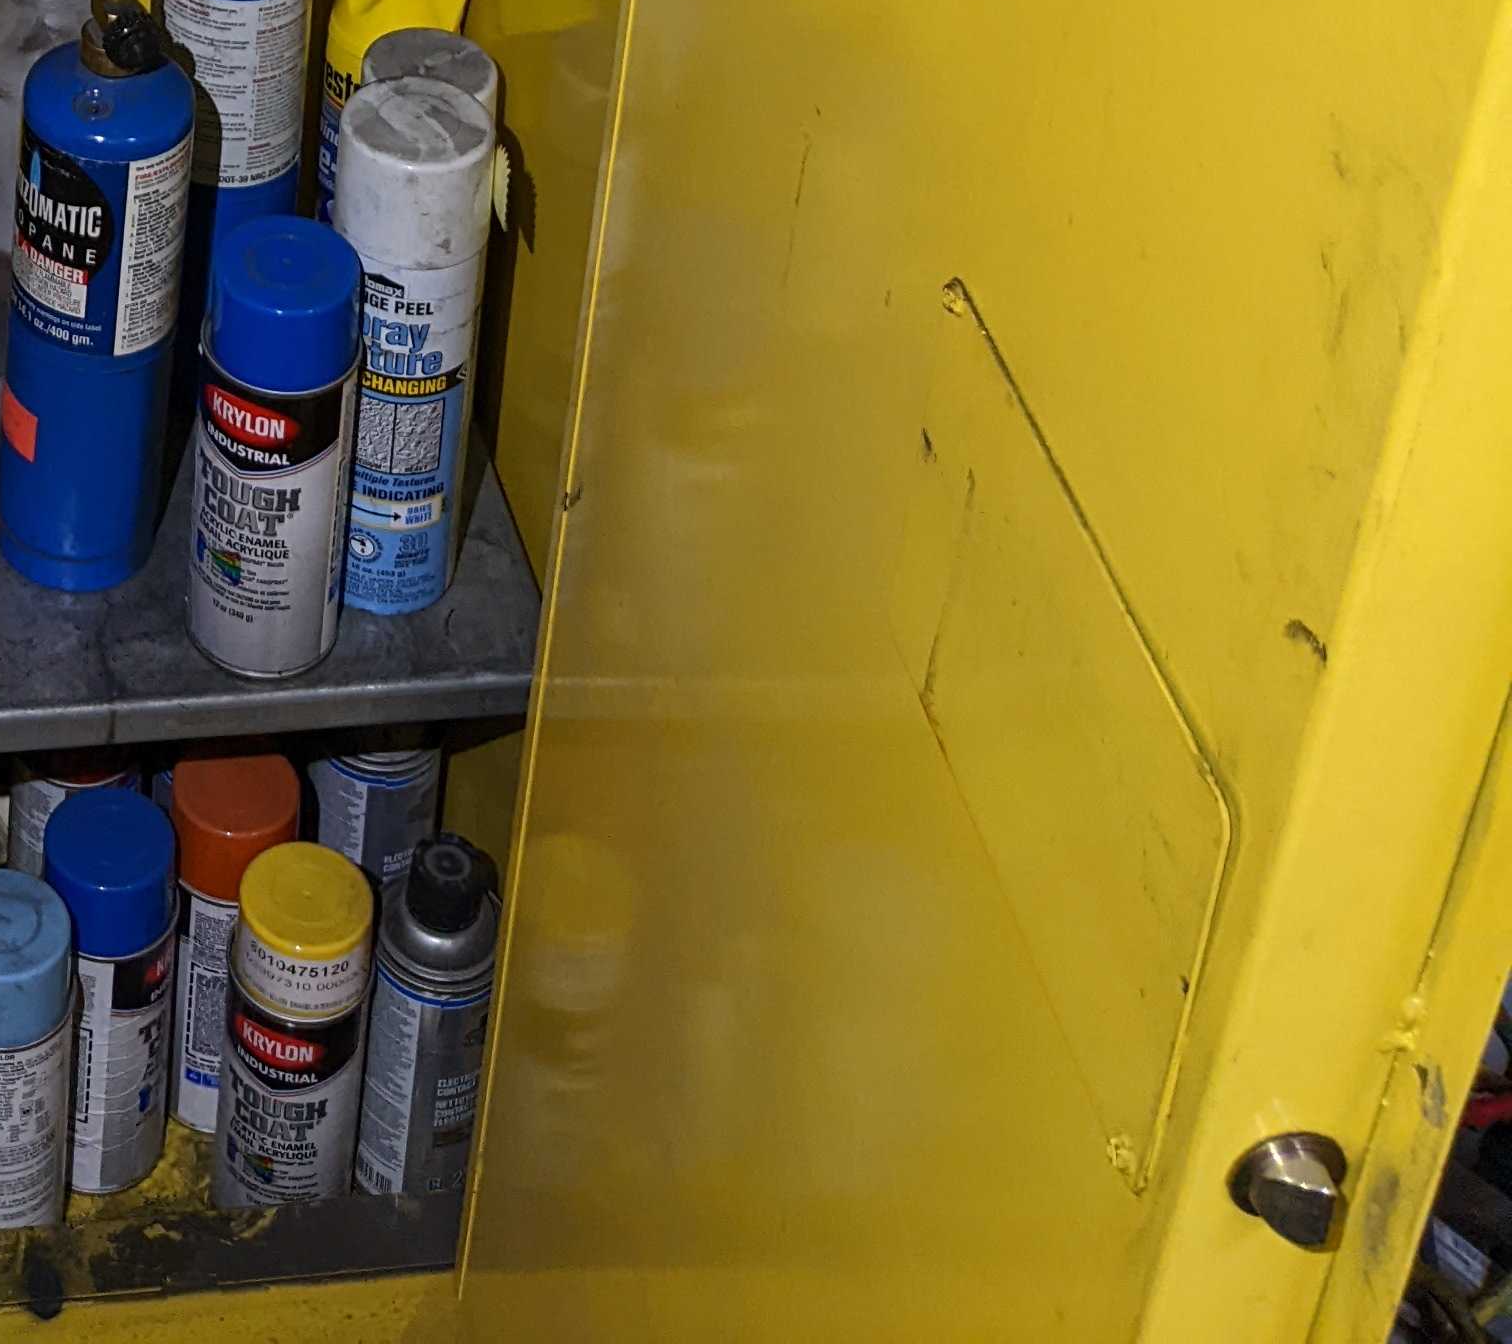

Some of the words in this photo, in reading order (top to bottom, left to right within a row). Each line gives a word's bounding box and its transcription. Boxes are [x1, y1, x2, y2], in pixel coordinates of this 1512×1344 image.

[30, 250, 85, 284] DANGER
[365, 276, 403, 298] omax
[395, 301, 434, 315] PEEL
[212, 391, 285, 440] KRYLON
[207, 420, 290, 465] INDUSTRIAL
[200, 448, 301, 512] TOUGH
[204, 482, 286, 537] COAT
[238, 534, 288, 549] ENAMEL
[241, 1022, 314, 1063] KRYLON
[238, 1046, 318, 1083] INDUSTRIAL
